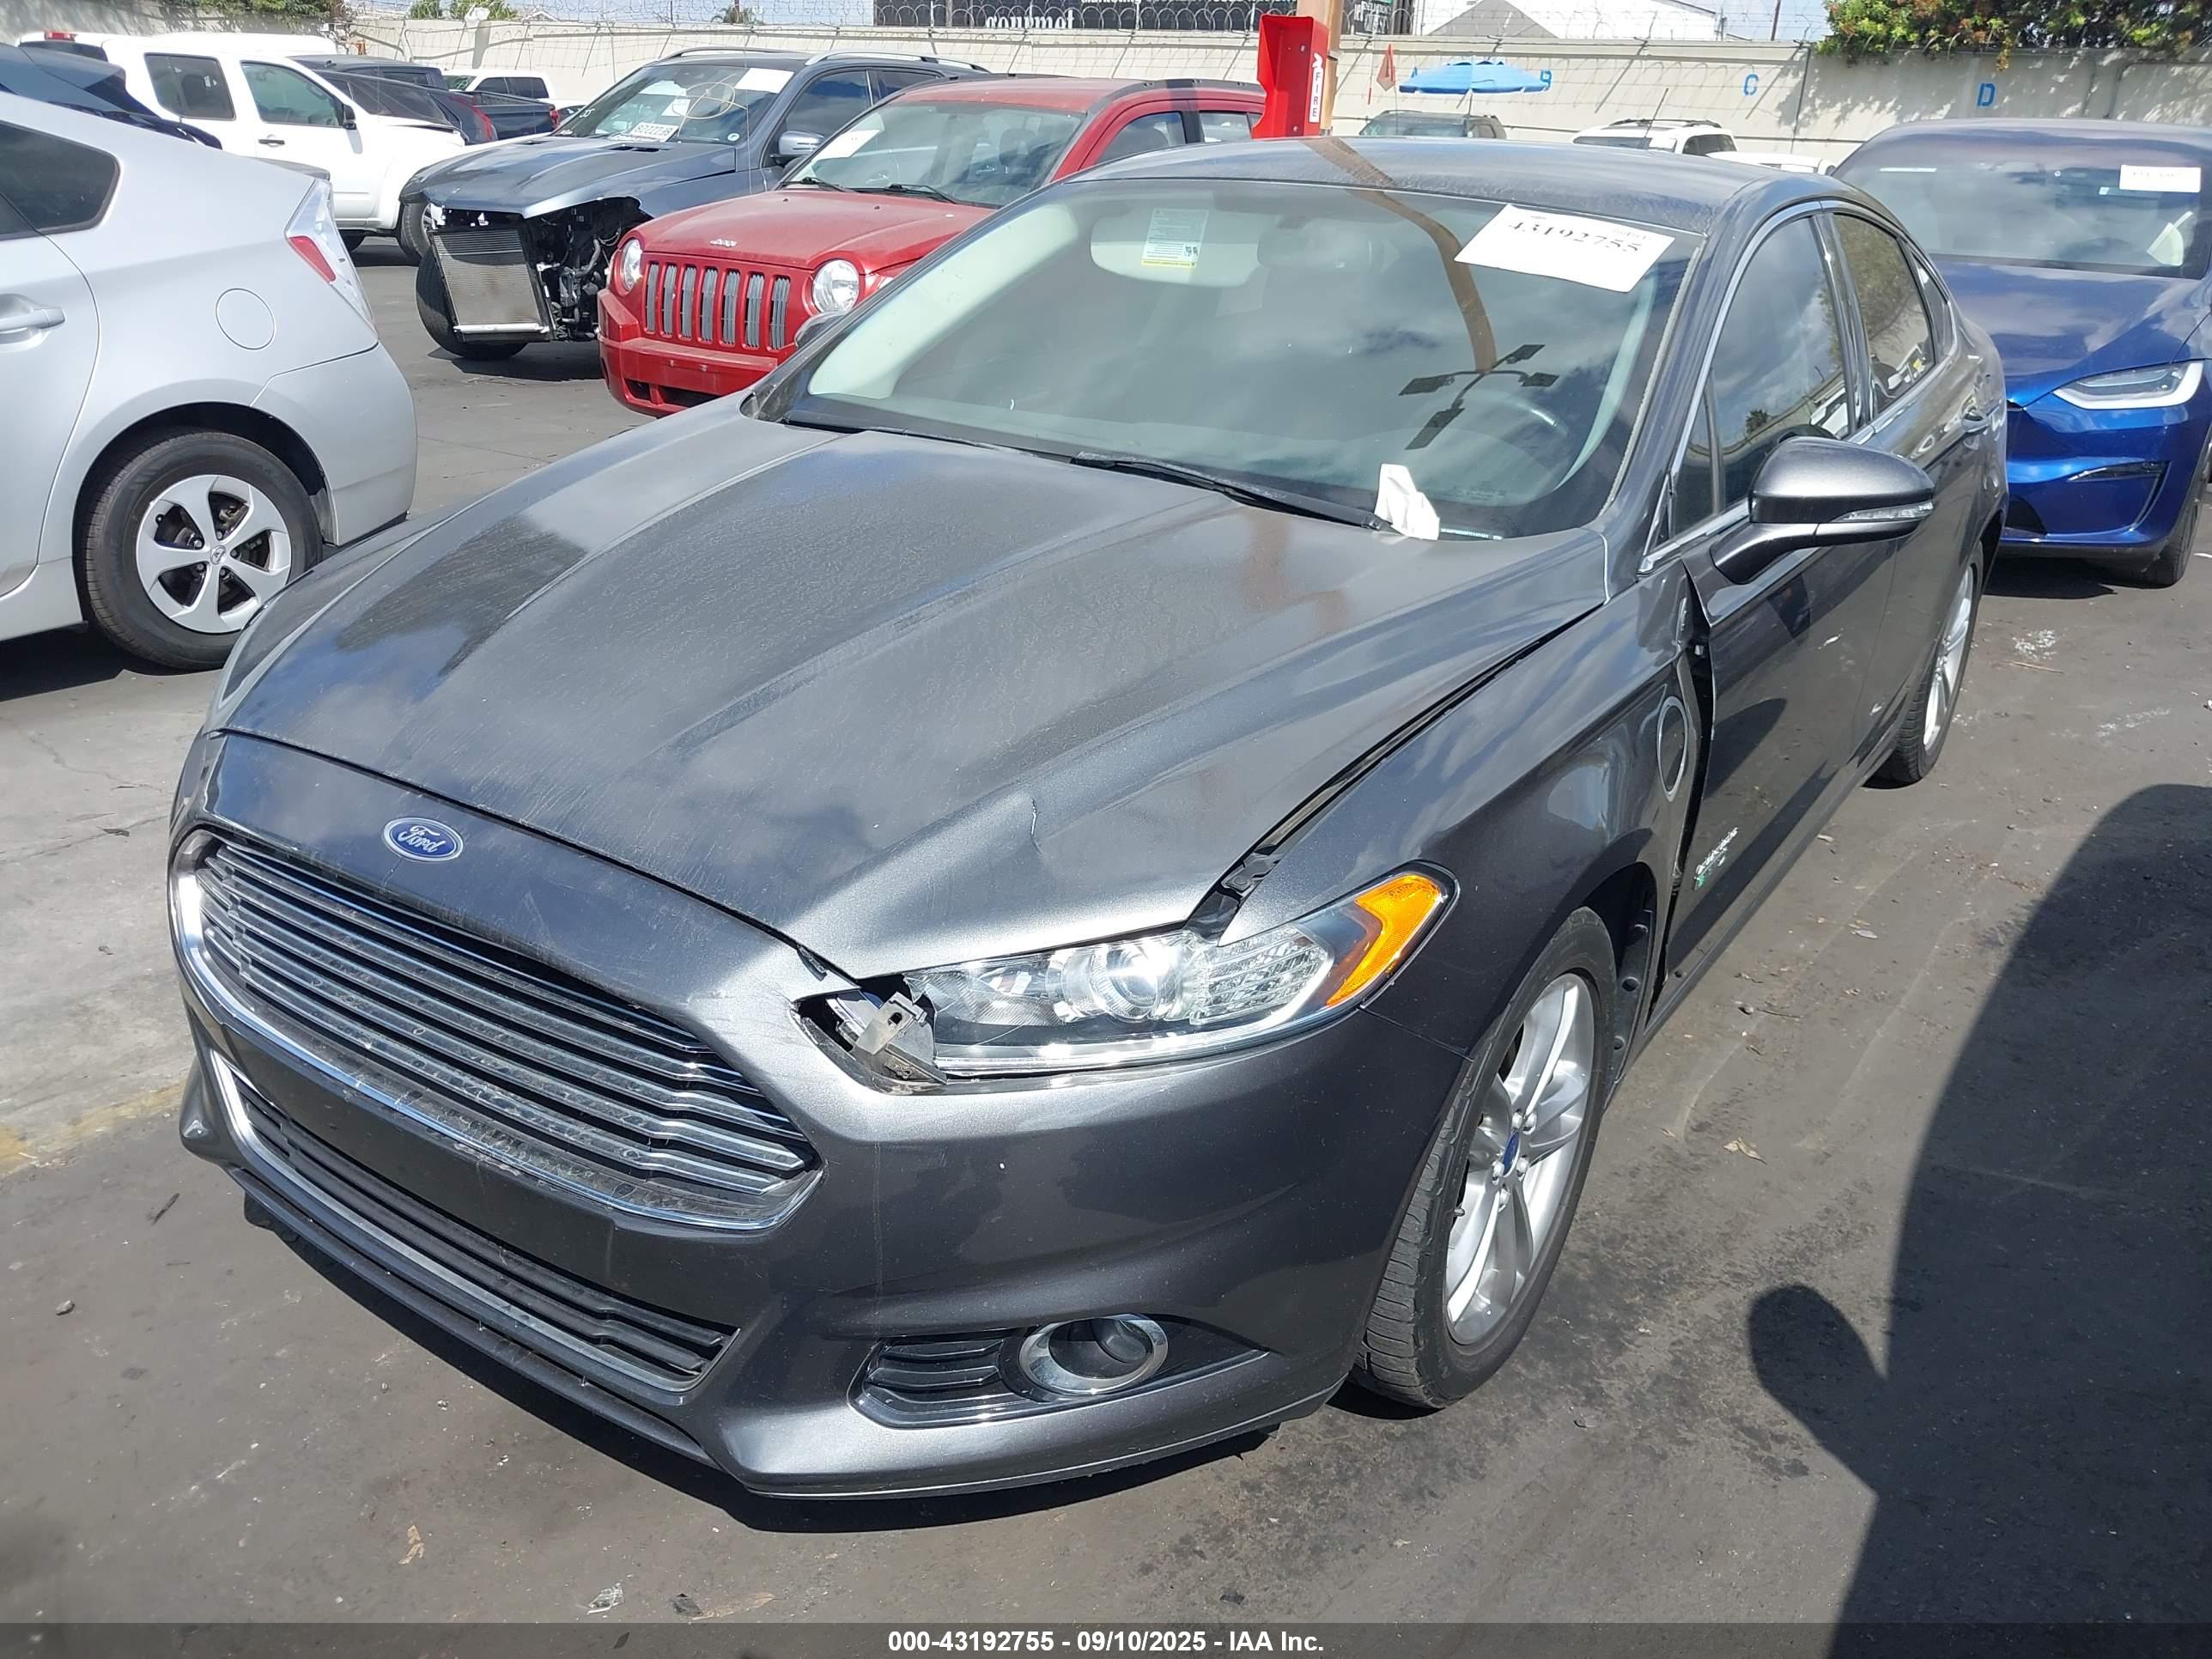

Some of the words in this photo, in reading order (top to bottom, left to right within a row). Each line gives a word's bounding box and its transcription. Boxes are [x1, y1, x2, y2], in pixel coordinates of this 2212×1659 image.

[1312, 72, 1322, 118] FIRE
[1744, 74, 1759, 95] C
[1978, 82, 1996, 106] D
[1508, 221, 1643, 252] 43192755
[397, 825, 447, 854] Ford
